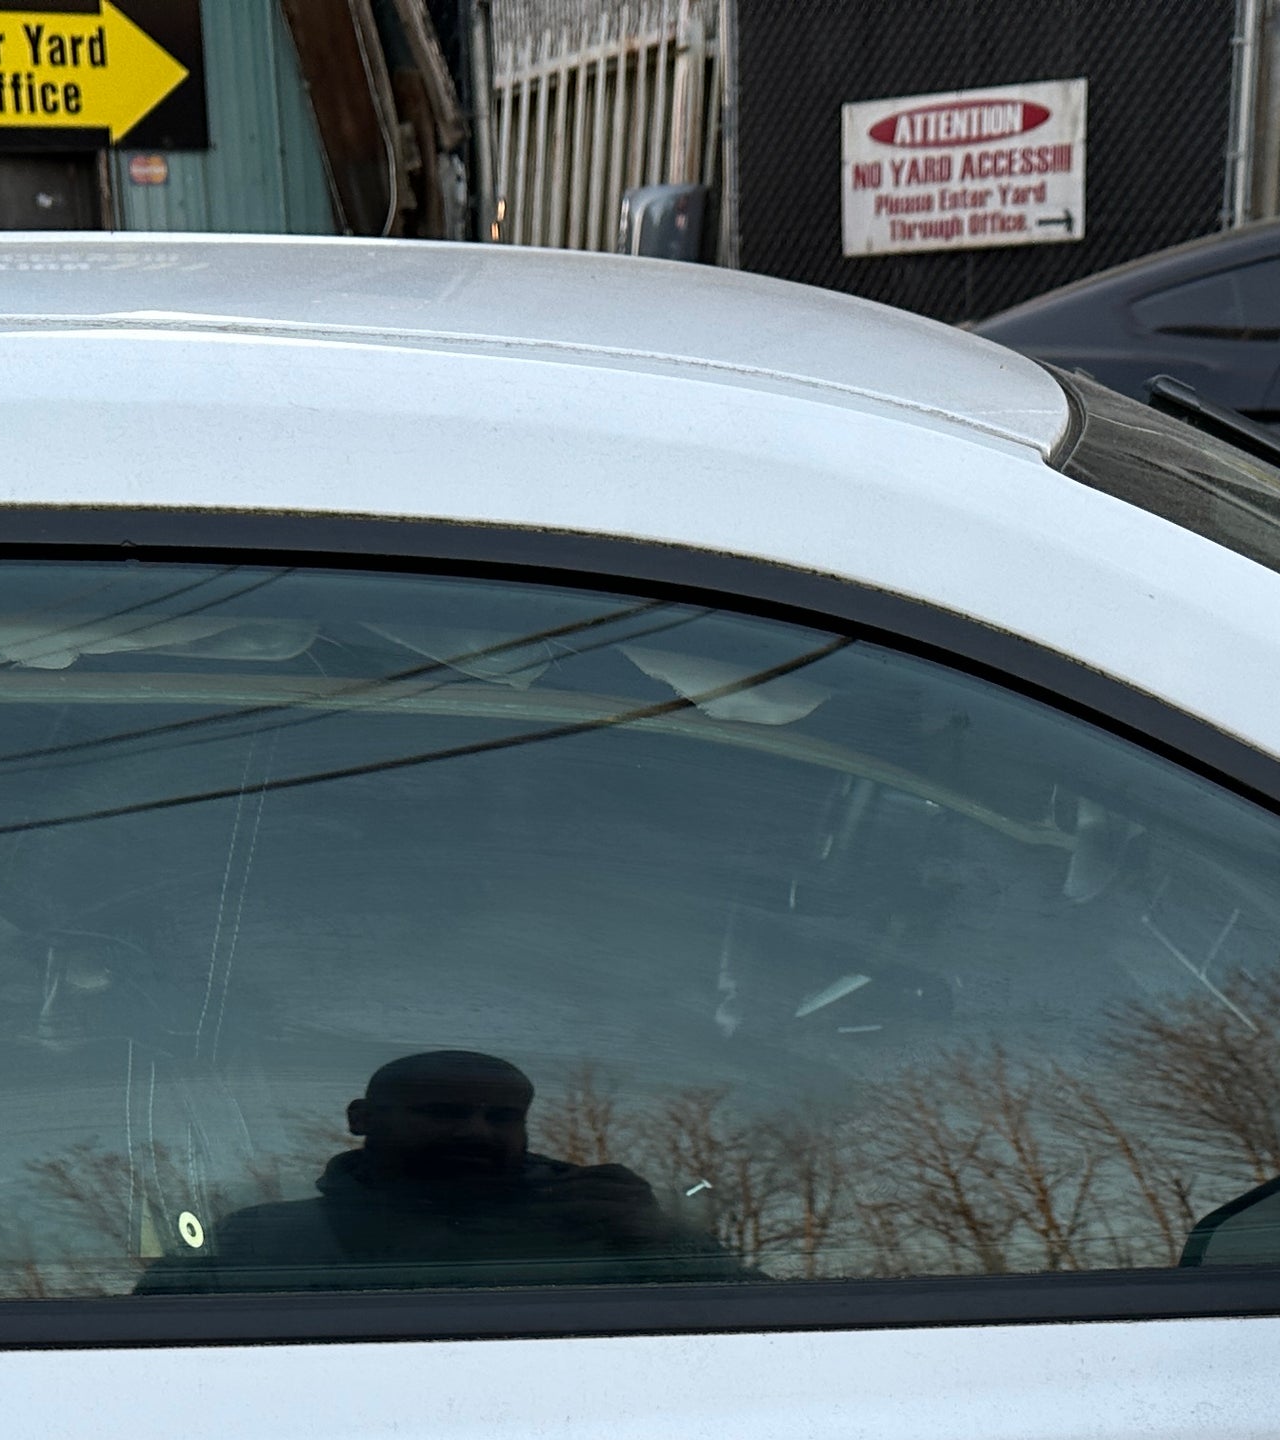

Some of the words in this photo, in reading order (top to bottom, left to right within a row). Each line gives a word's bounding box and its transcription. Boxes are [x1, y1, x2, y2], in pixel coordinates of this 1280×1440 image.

[23, 23, 108, 68] Yard
[894, 103, 1023, 144] ATTENTION
[853, 162, 882, 190] NO
[891, 154, 953, 186] YARD
[874, 192, 933, 215] Please
[938, 187, 993, 210] Enter
[998, 181, 1047, 206] Yard
[889, 216, 963, 242] Through
